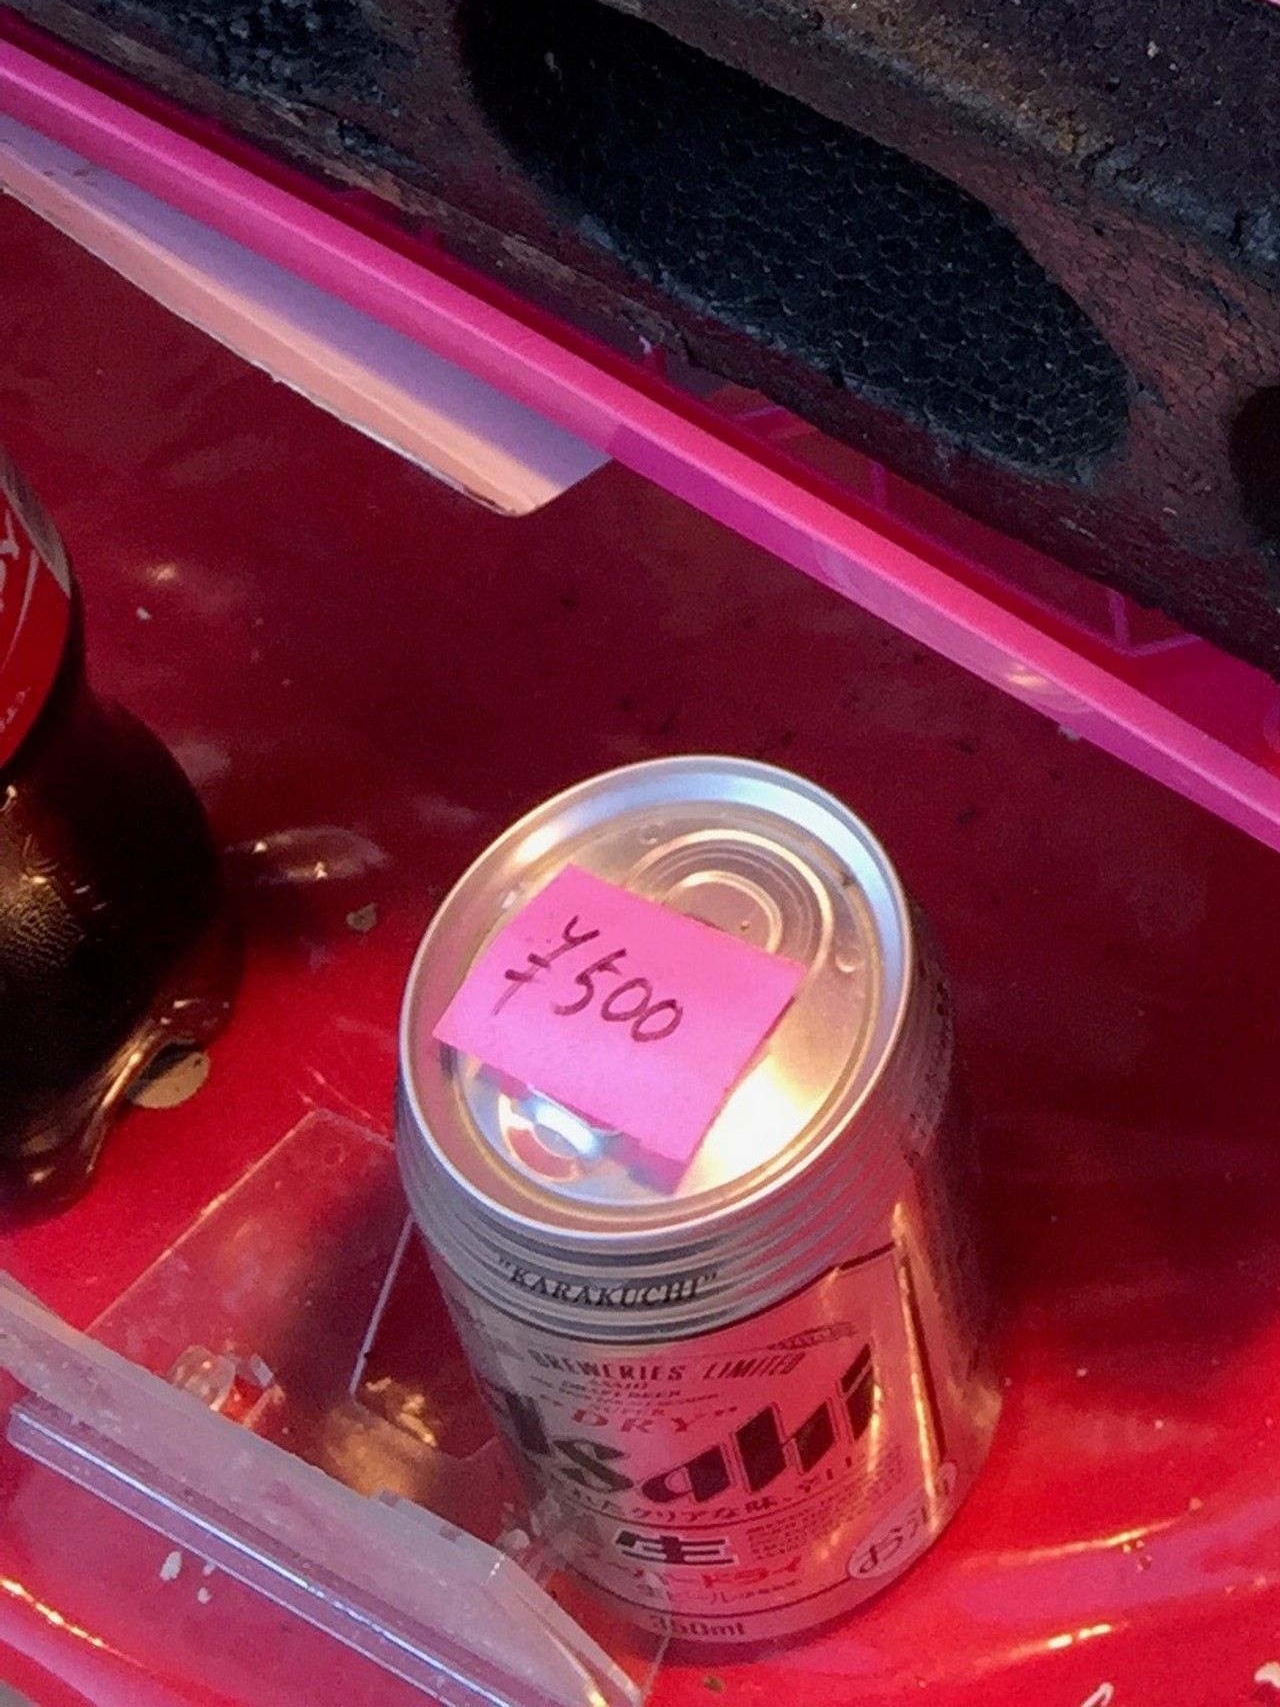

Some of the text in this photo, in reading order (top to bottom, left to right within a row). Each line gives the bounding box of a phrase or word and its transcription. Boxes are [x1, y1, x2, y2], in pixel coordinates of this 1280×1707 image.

[488, 915, 684, 1042] ¥500
[527, 1348, 807, 1382] BREWERIES LIMITED
[614, 1529, 737, 1566] 生
